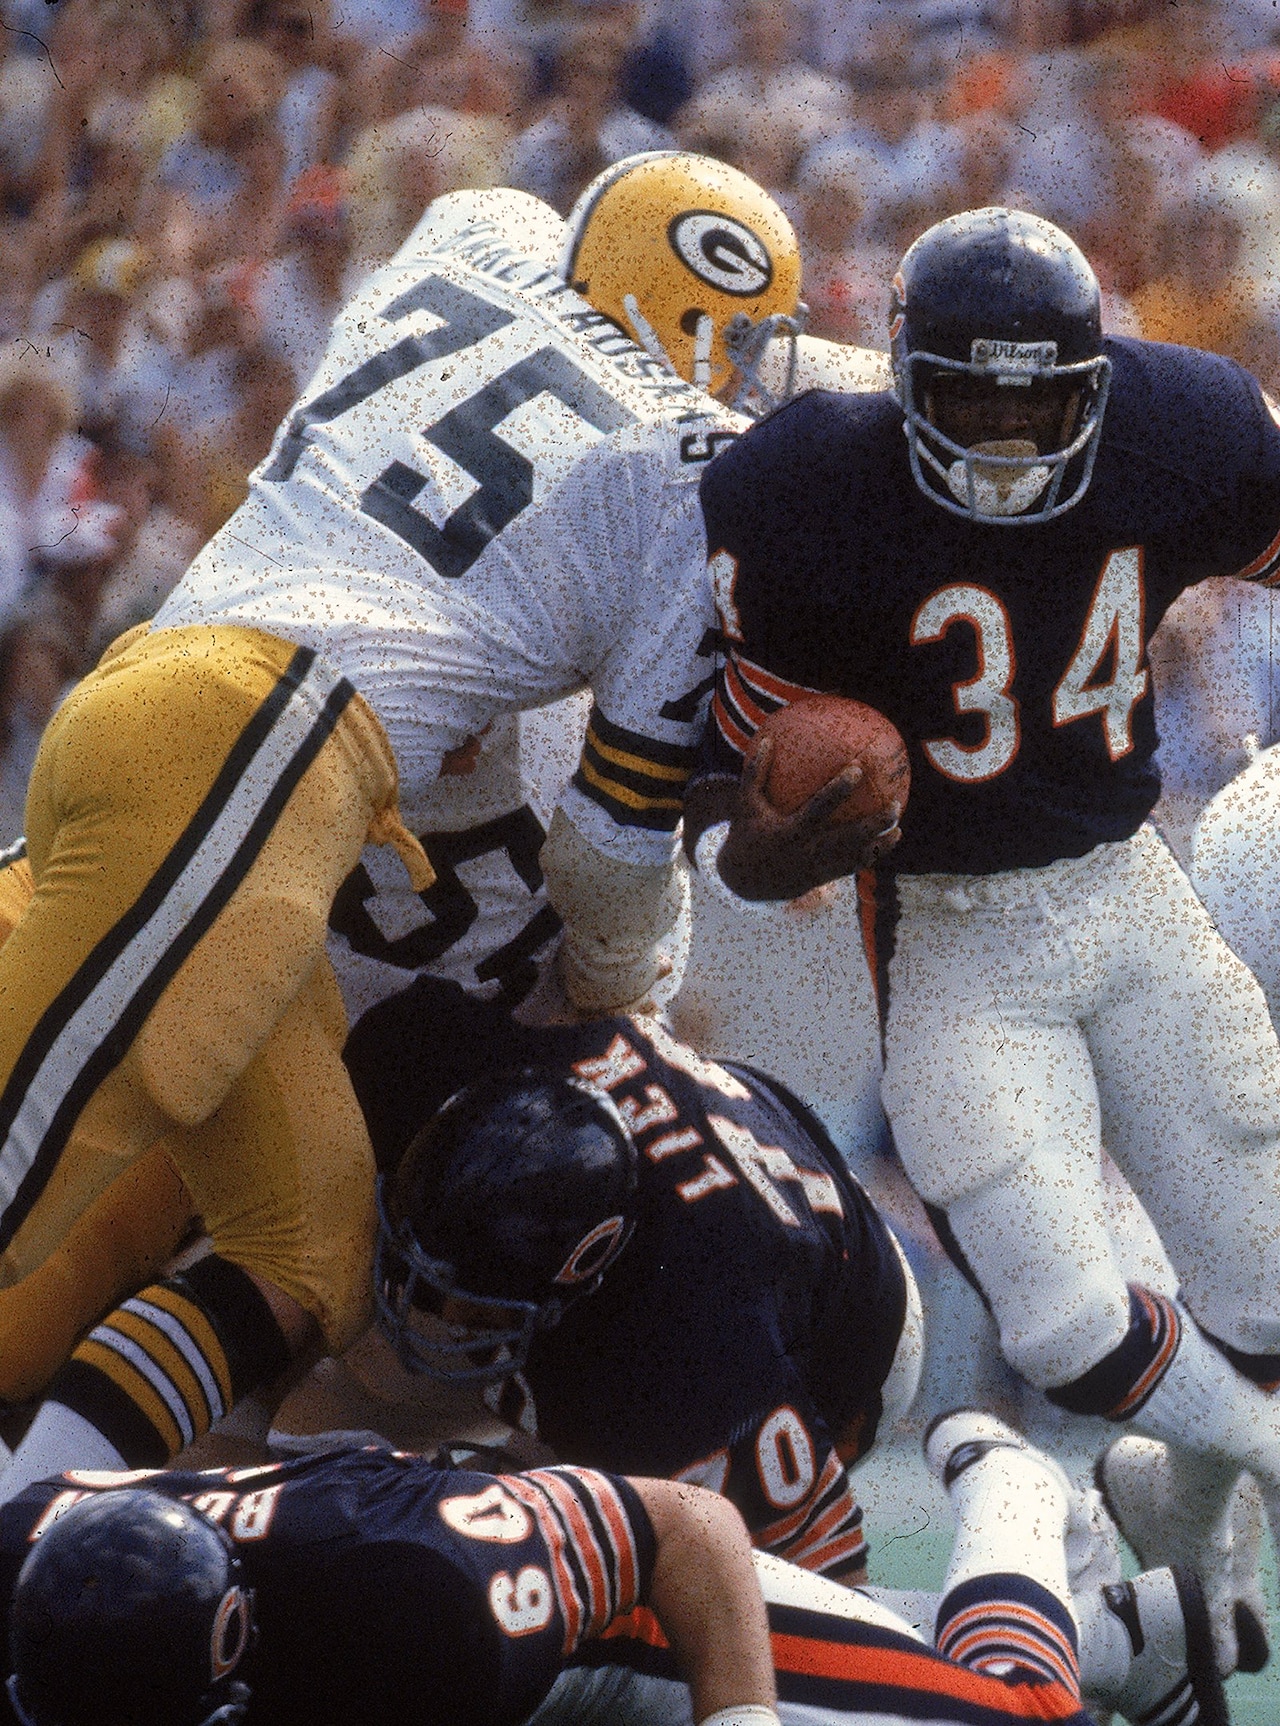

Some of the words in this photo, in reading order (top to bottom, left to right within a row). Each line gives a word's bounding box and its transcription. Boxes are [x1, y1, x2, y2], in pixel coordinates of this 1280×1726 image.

[257, 271, 640, 579] 75
[986, 342, 1041, 361] Wilson
[909, 545, 1150, 784] 34
[571, 1032, 740, 1204] LICK
